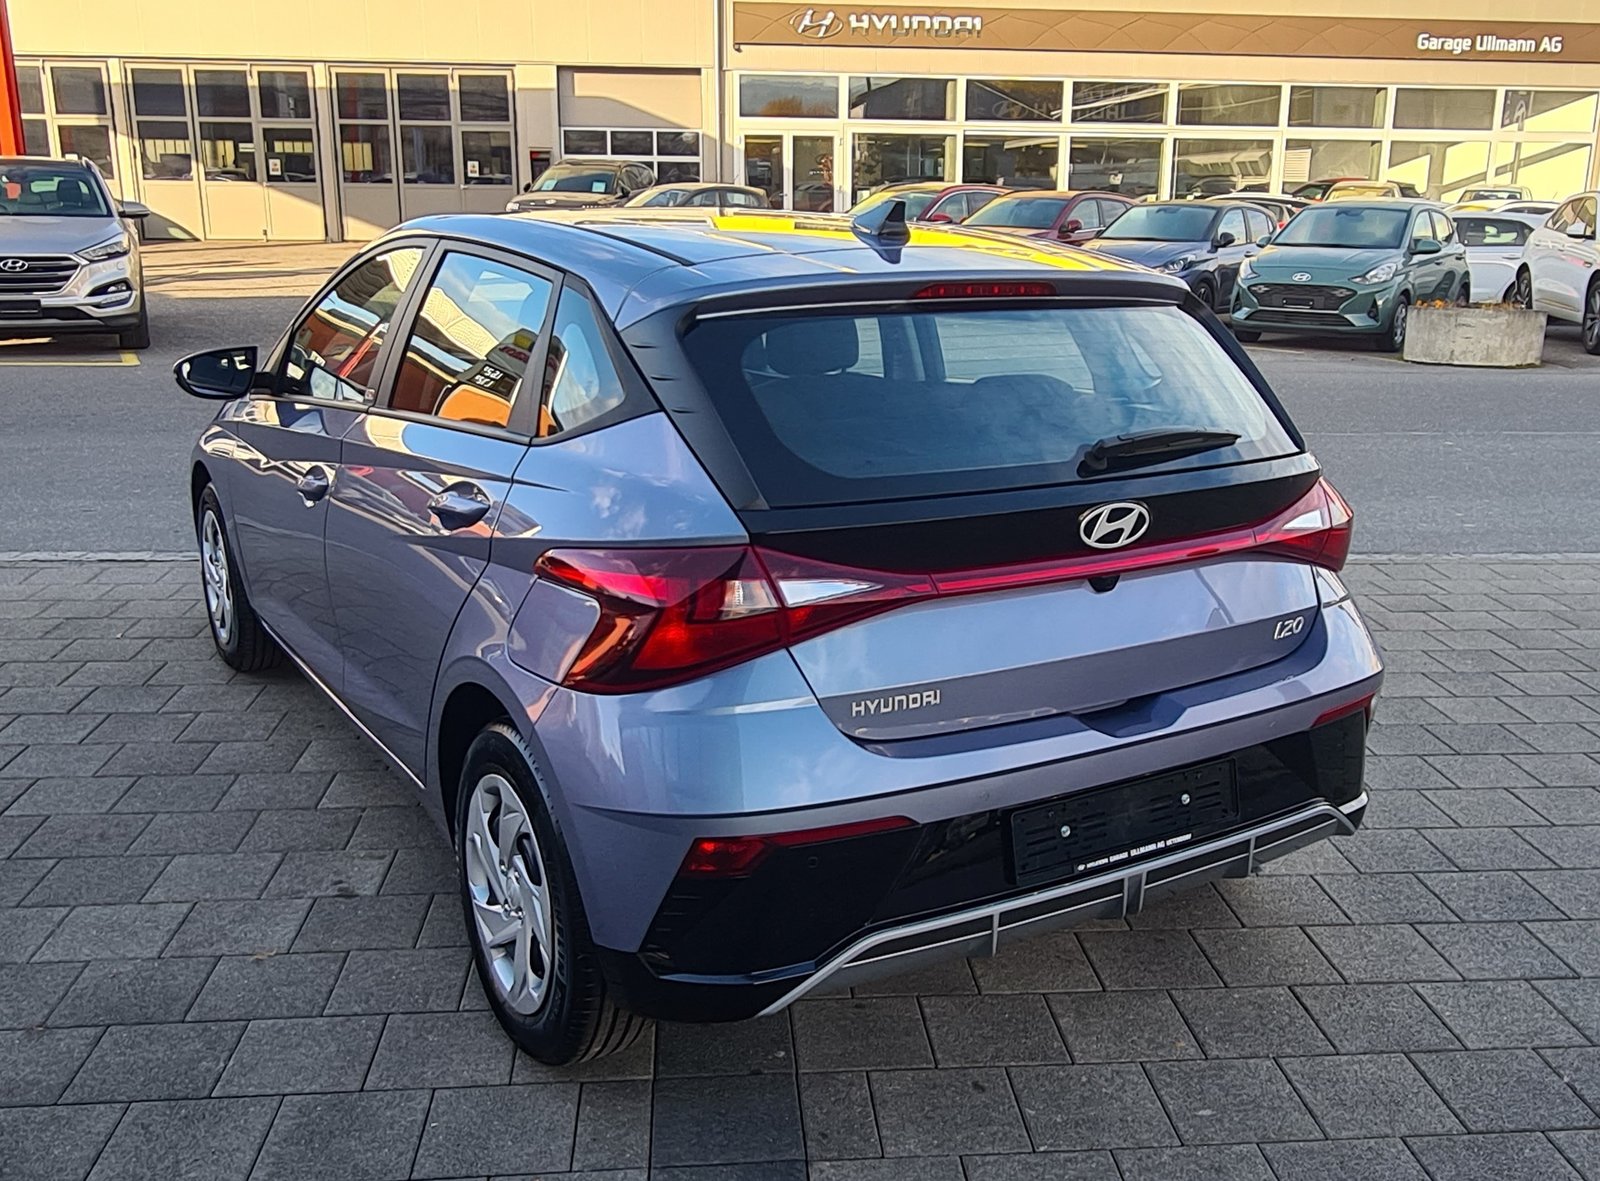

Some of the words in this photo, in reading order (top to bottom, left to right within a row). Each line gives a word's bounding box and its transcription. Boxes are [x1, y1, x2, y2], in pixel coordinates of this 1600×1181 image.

[849, 13, 982, 37] HYUNDAI
[1417, 33, 1471, 54] Garage
[1475, 35, 1536, 52] Ullmann
[1539, 36, 1563, 53] AG
[851, 689, 940, 717] HYUNDAI
